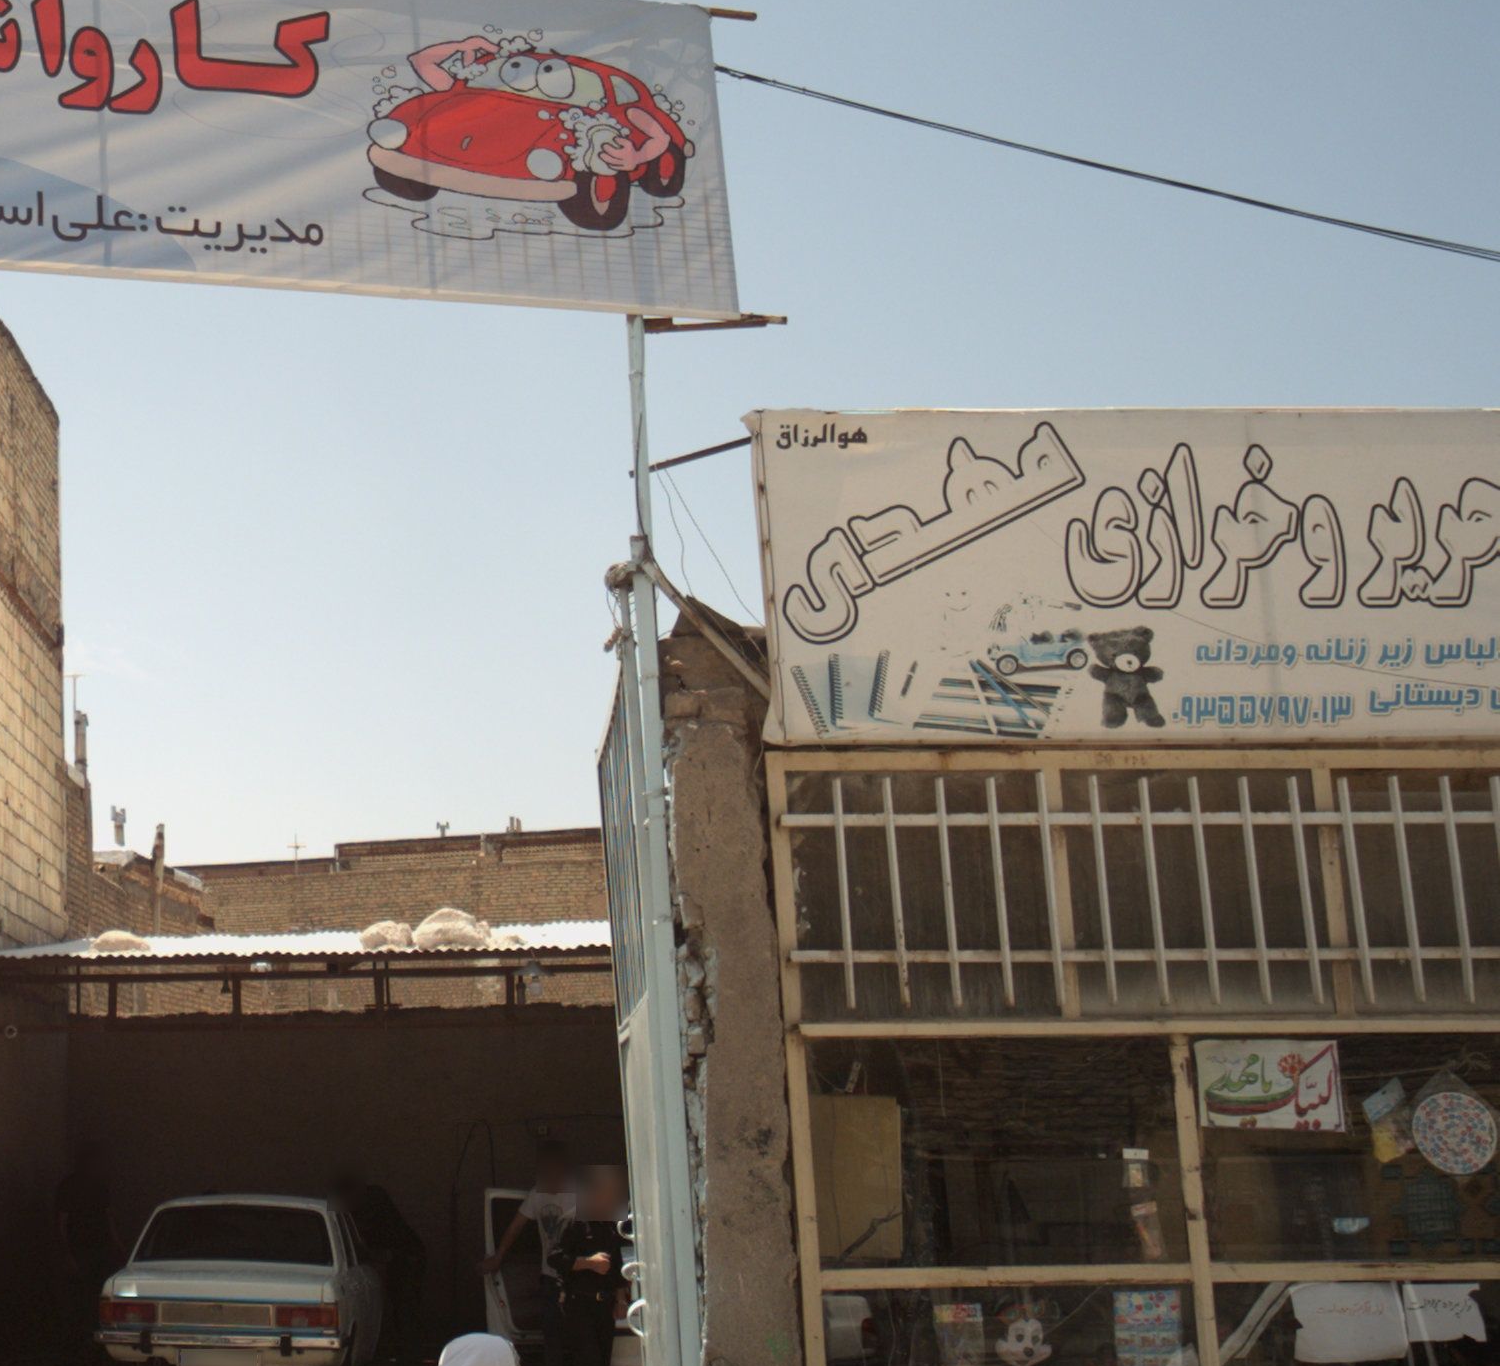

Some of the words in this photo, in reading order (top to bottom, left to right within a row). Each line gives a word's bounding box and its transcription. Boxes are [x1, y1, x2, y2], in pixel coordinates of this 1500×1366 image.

[783, 421, 1086, 645] مهدی
[1065, 442, 1300, 609] خرازی
[1305, 637, 1368, 666] زنانه
[1378, 637, 1415, 669] زیر
[1424, 636, 1496, 668] لباس
[1368, 682, 1481, 714] دبستانی
